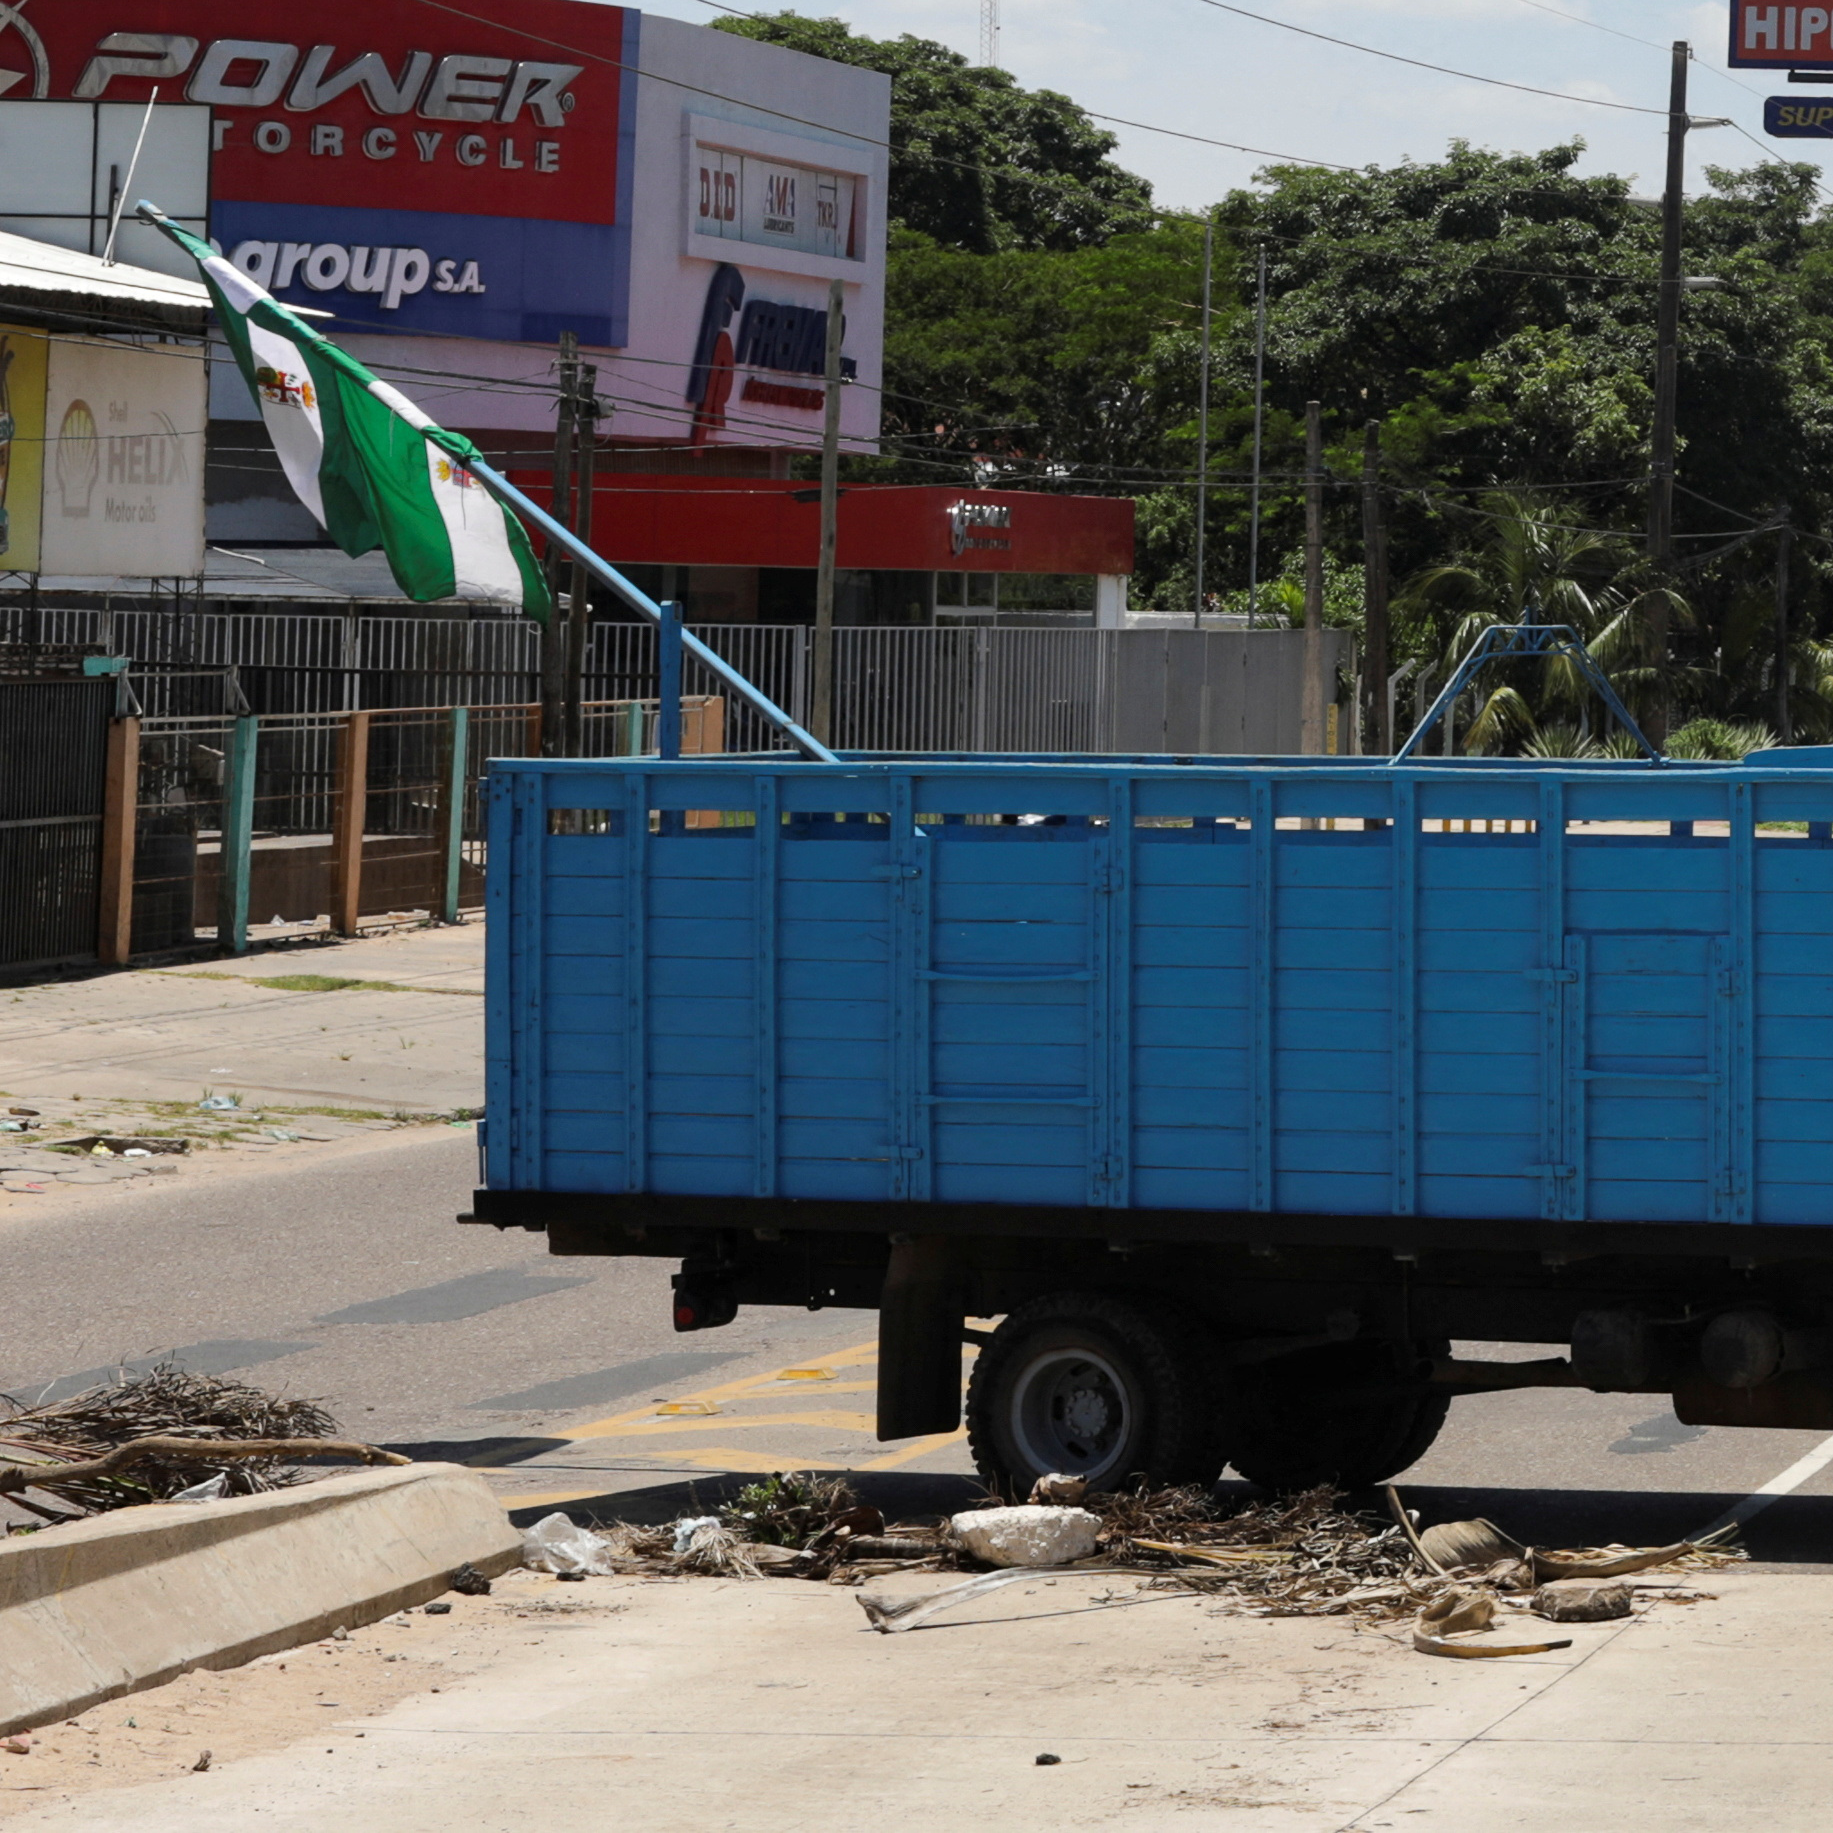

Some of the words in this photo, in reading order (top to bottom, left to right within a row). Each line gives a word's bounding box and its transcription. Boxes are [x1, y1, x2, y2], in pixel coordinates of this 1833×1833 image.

[72, 32, 585, 128] POWER
[213, 119, 561, 173] TORCYCLE
[432, 259, 486, 293] S.A.
[108, 400, 128, 422] Shell
[107, 435, 187, 485] HELIX
[104, 498, 138, 523] Motor
[138, 496, 156, 522] oils
